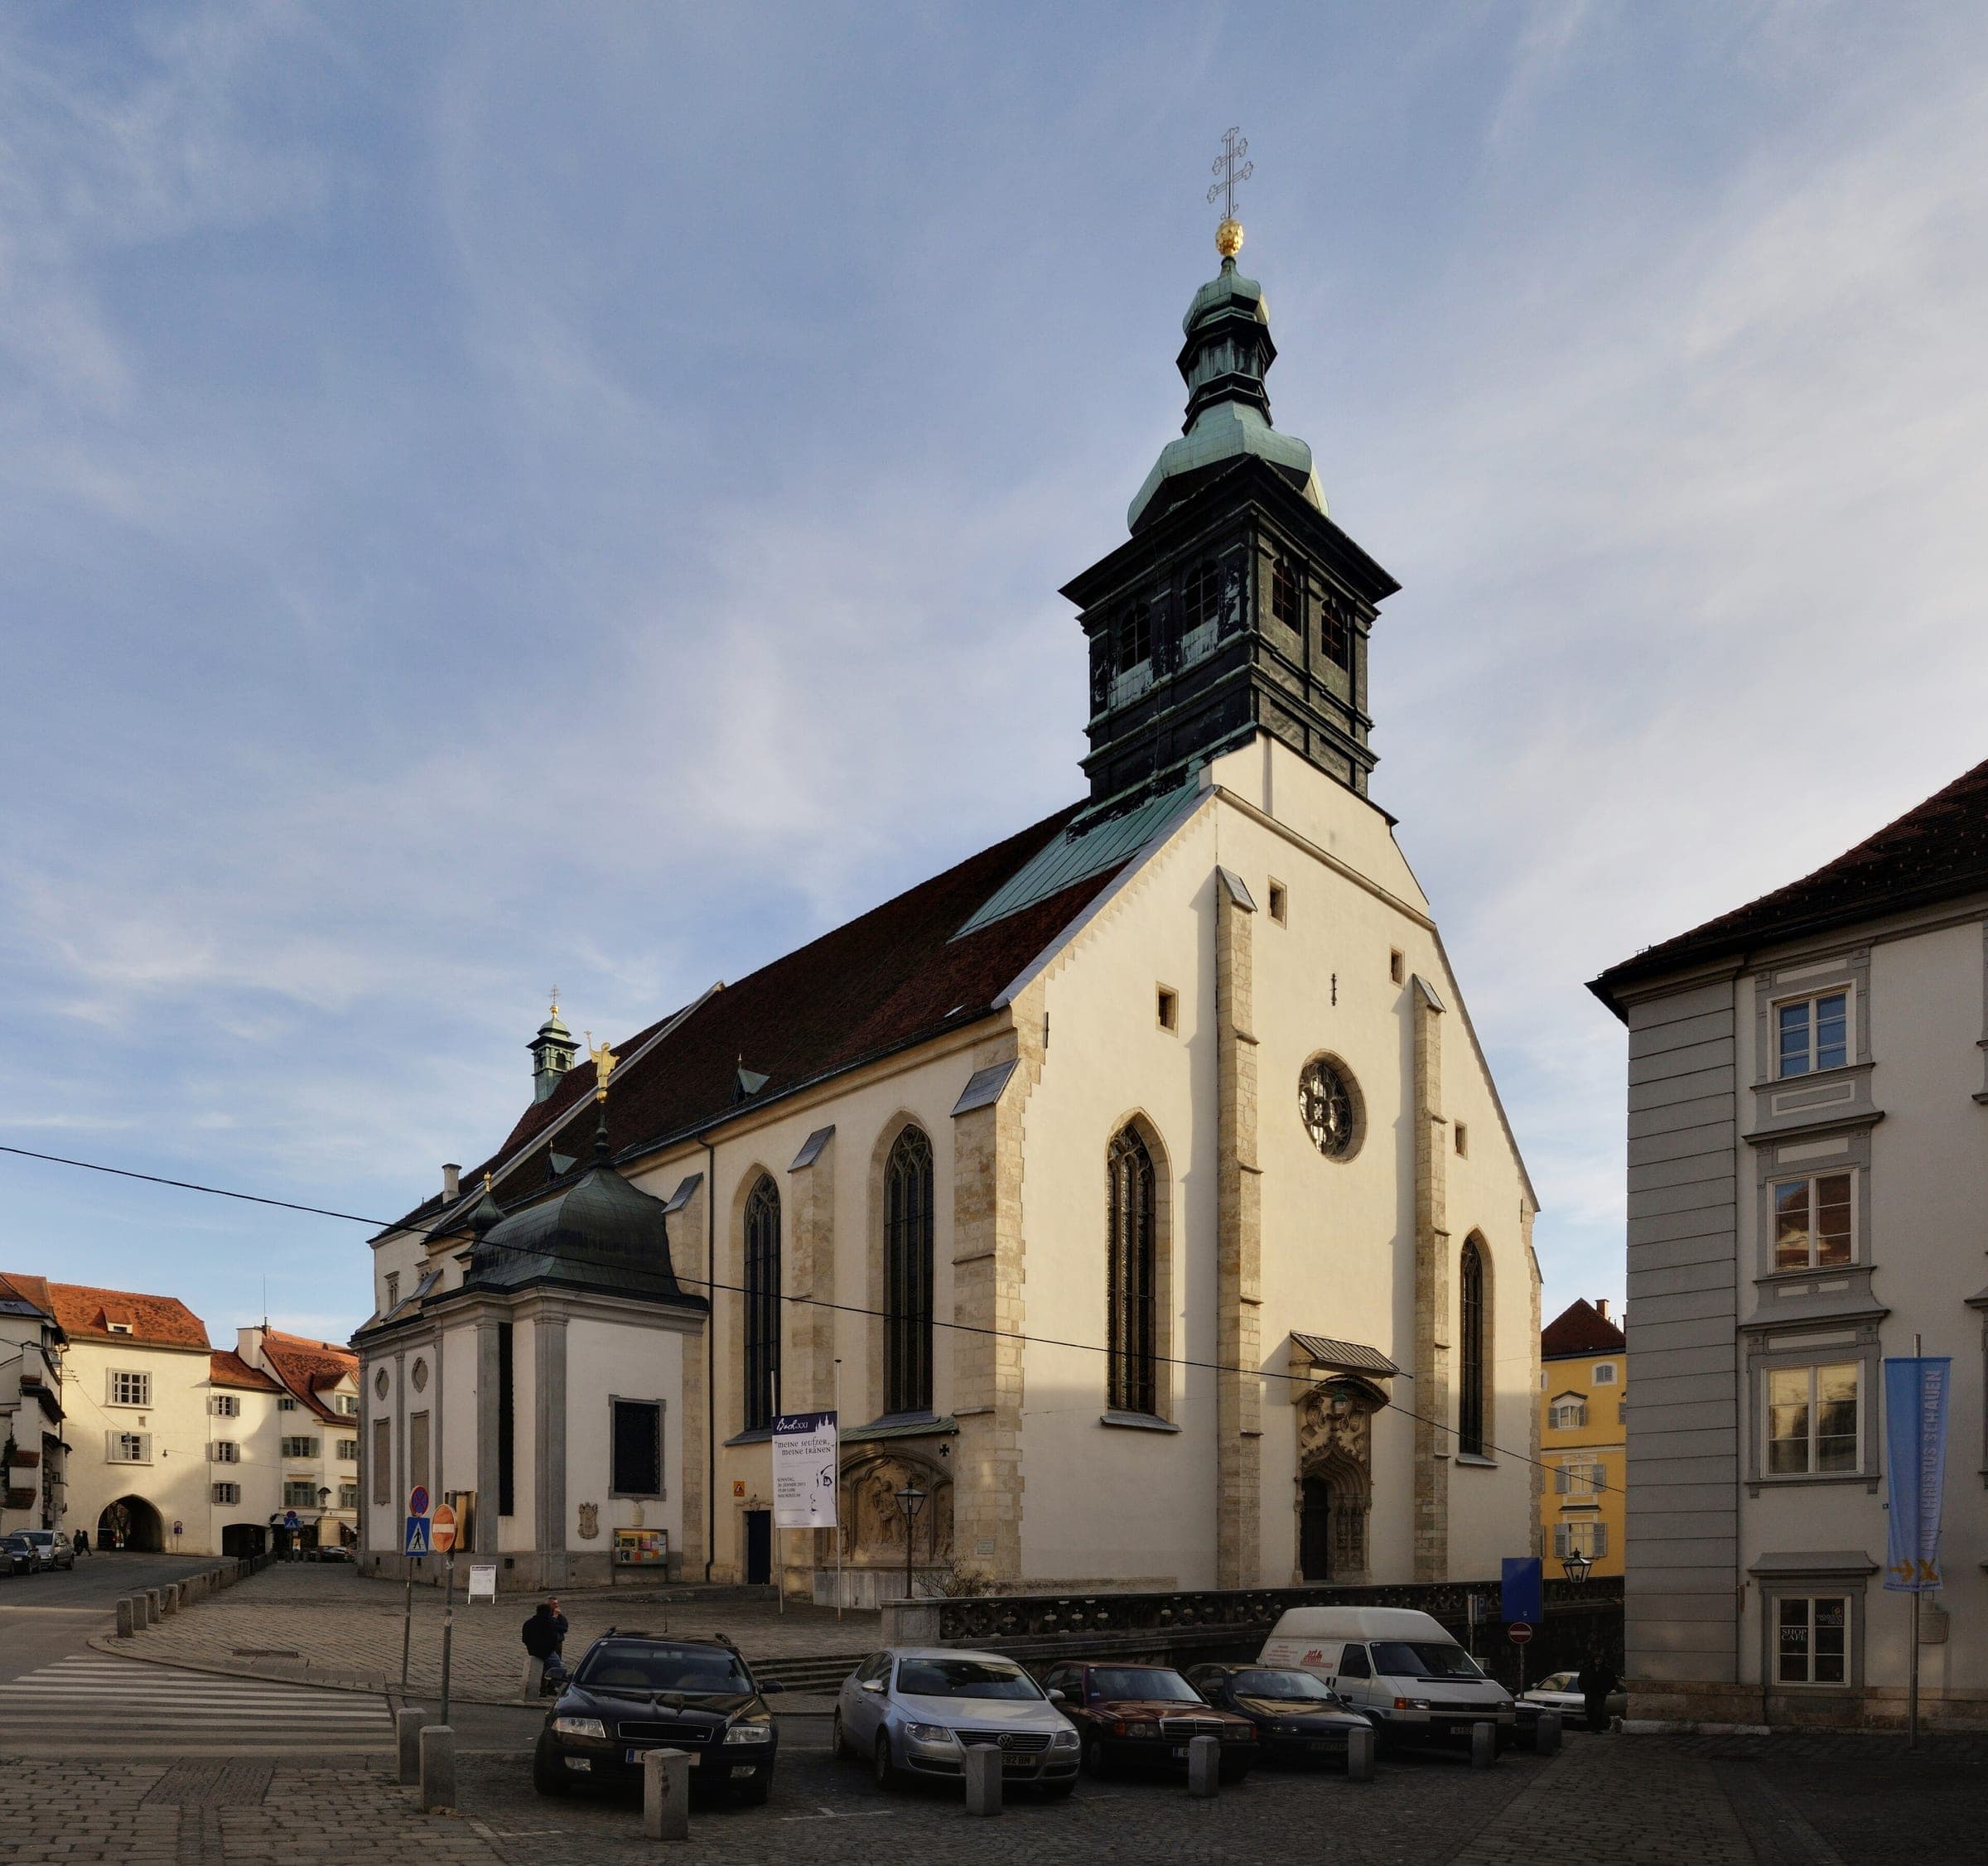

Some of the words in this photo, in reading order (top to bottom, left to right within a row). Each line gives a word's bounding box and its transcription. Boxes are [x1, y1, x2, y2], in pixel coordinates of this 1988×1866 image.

[1923, 1370, 1942, 1443] SCHAUEN
[1921, 1447, 1937, 1519] CHRISTUS
[1920, 1526, 1936, 1551] AUF
